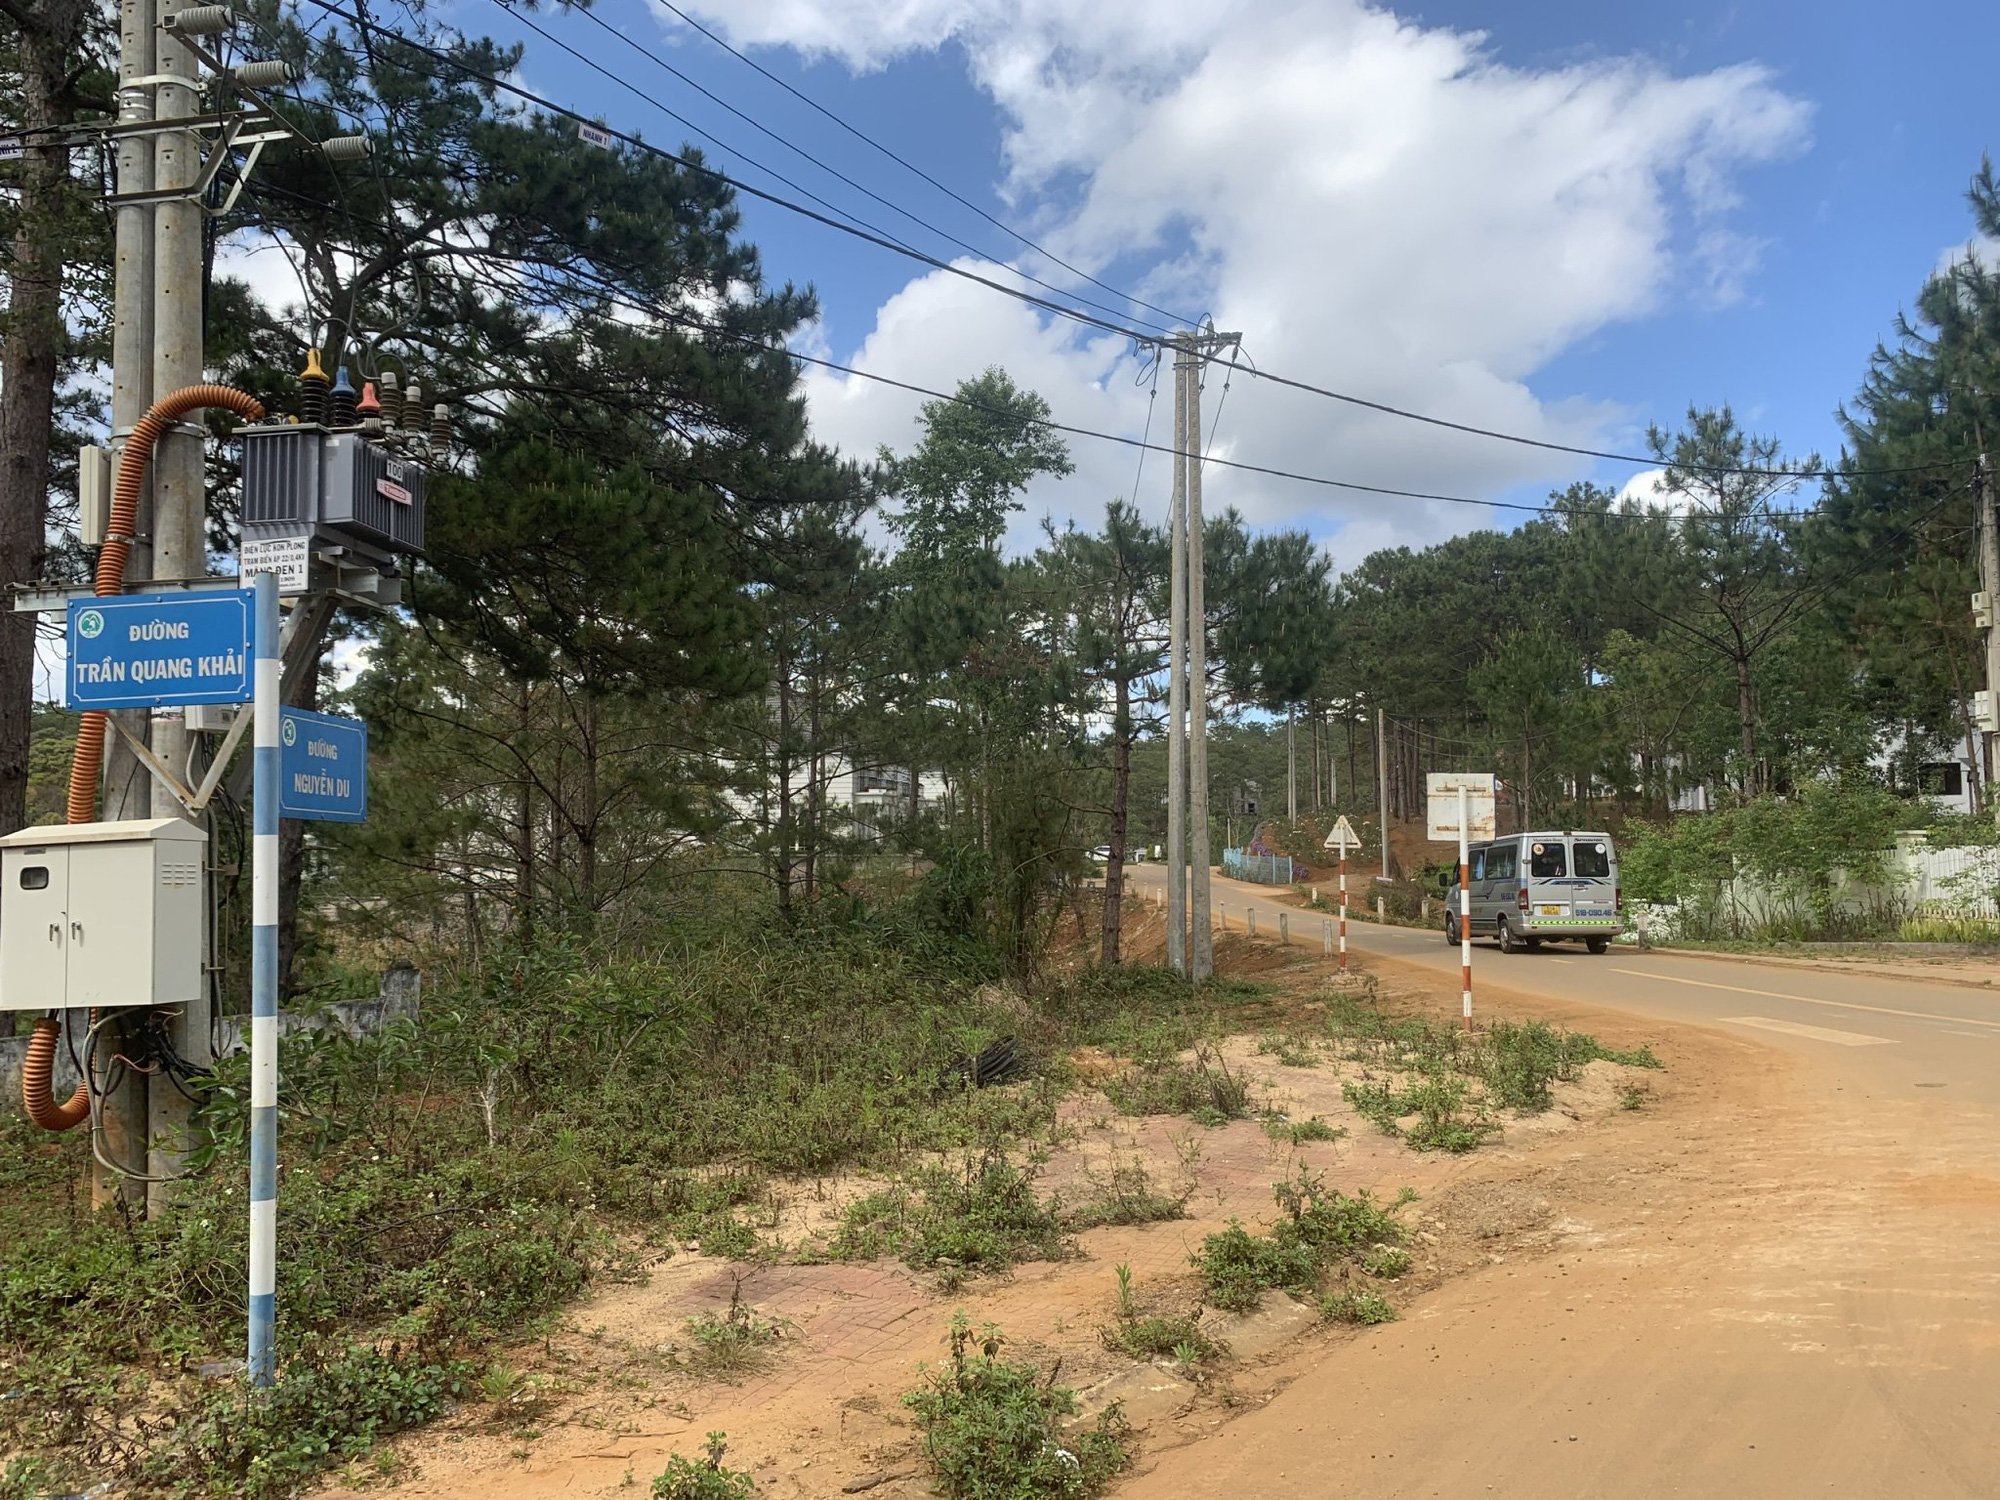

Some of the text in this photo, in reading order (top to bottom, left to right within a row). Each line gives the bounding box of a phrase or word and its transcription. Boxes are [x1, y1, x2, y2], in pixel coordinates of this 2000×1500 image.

[388, 462, 402, 478] 100
[275, 564, 295, 575] ĐEN
[298, 564, 303, 573] 1
[129, 618, 189, 641] ĐƯỜNG
[77, 648, 243, 684] TRẦN QUANG KHẢI
[308, 737, 338, 760] ĐƯỜNG
[294, 769, 350, 797] NGUYỄN DU
